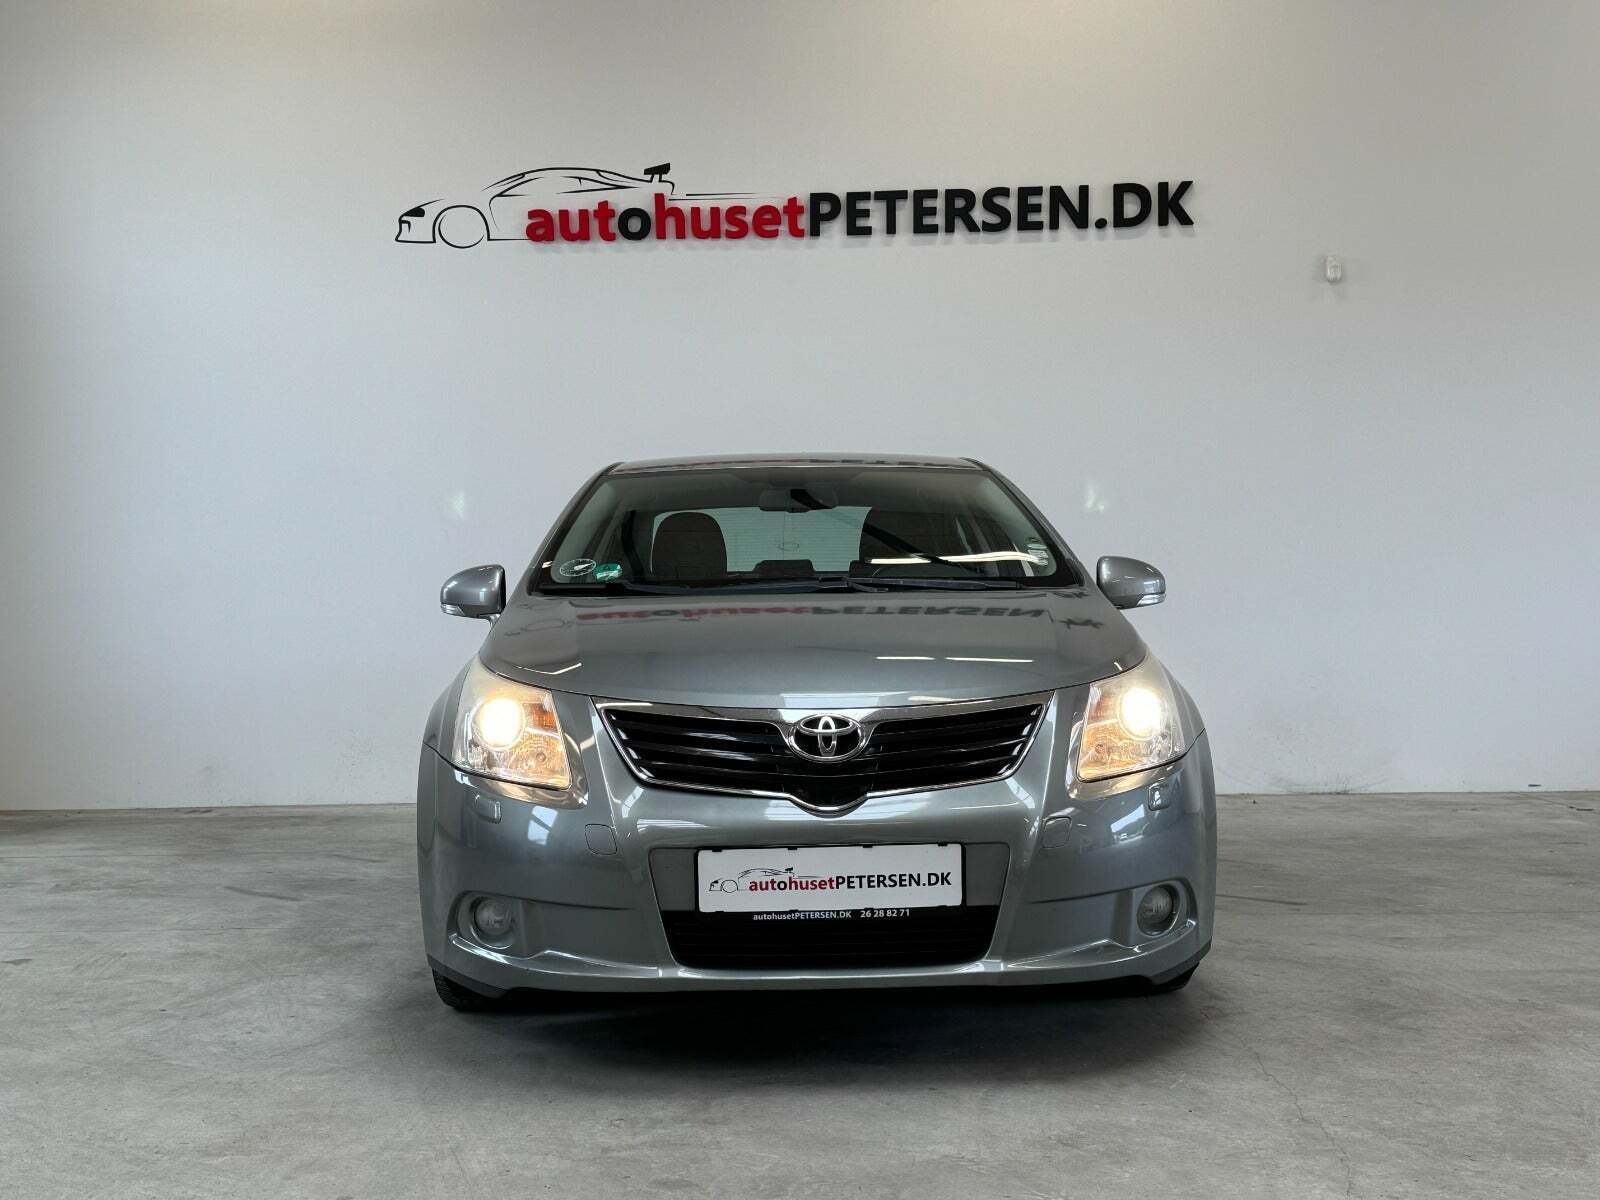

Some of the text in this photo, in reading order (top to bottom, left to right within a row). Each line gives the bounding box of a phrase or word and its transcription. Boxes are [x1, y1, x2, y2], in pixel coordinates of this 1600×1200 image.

[860, 909, 871, 919] 26
[874, 909, 885, 919] 28
[887, 909, 898, 918] 82
[901, 908, 911, 917] 71
